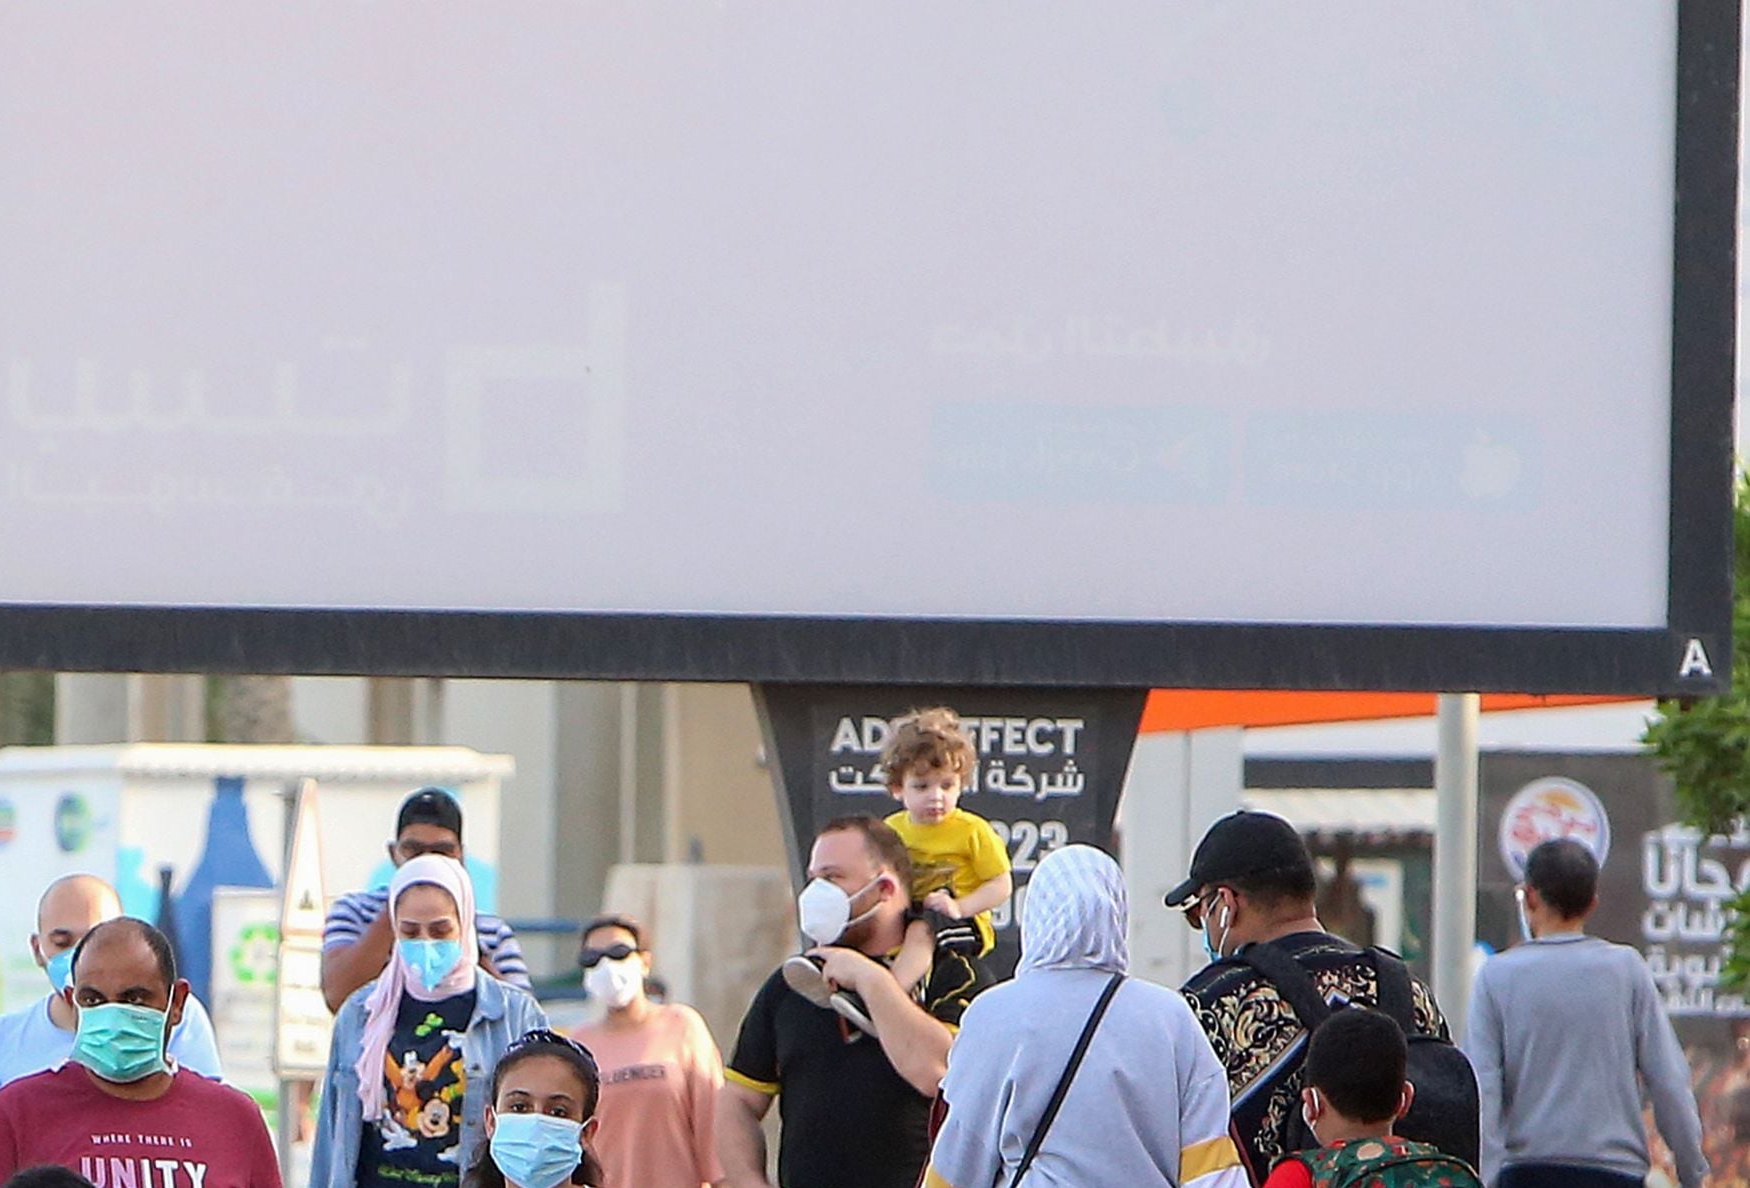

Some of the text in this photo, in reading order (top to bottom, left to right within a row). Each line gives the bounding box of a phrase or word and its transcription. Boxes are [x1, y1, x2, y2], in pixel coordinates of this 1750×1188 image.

[1679, 637, 1712, 677] A
[985, 759, 1085, 801] شركة
[91, 1133, 192, 1147] WHERE THERE IS
